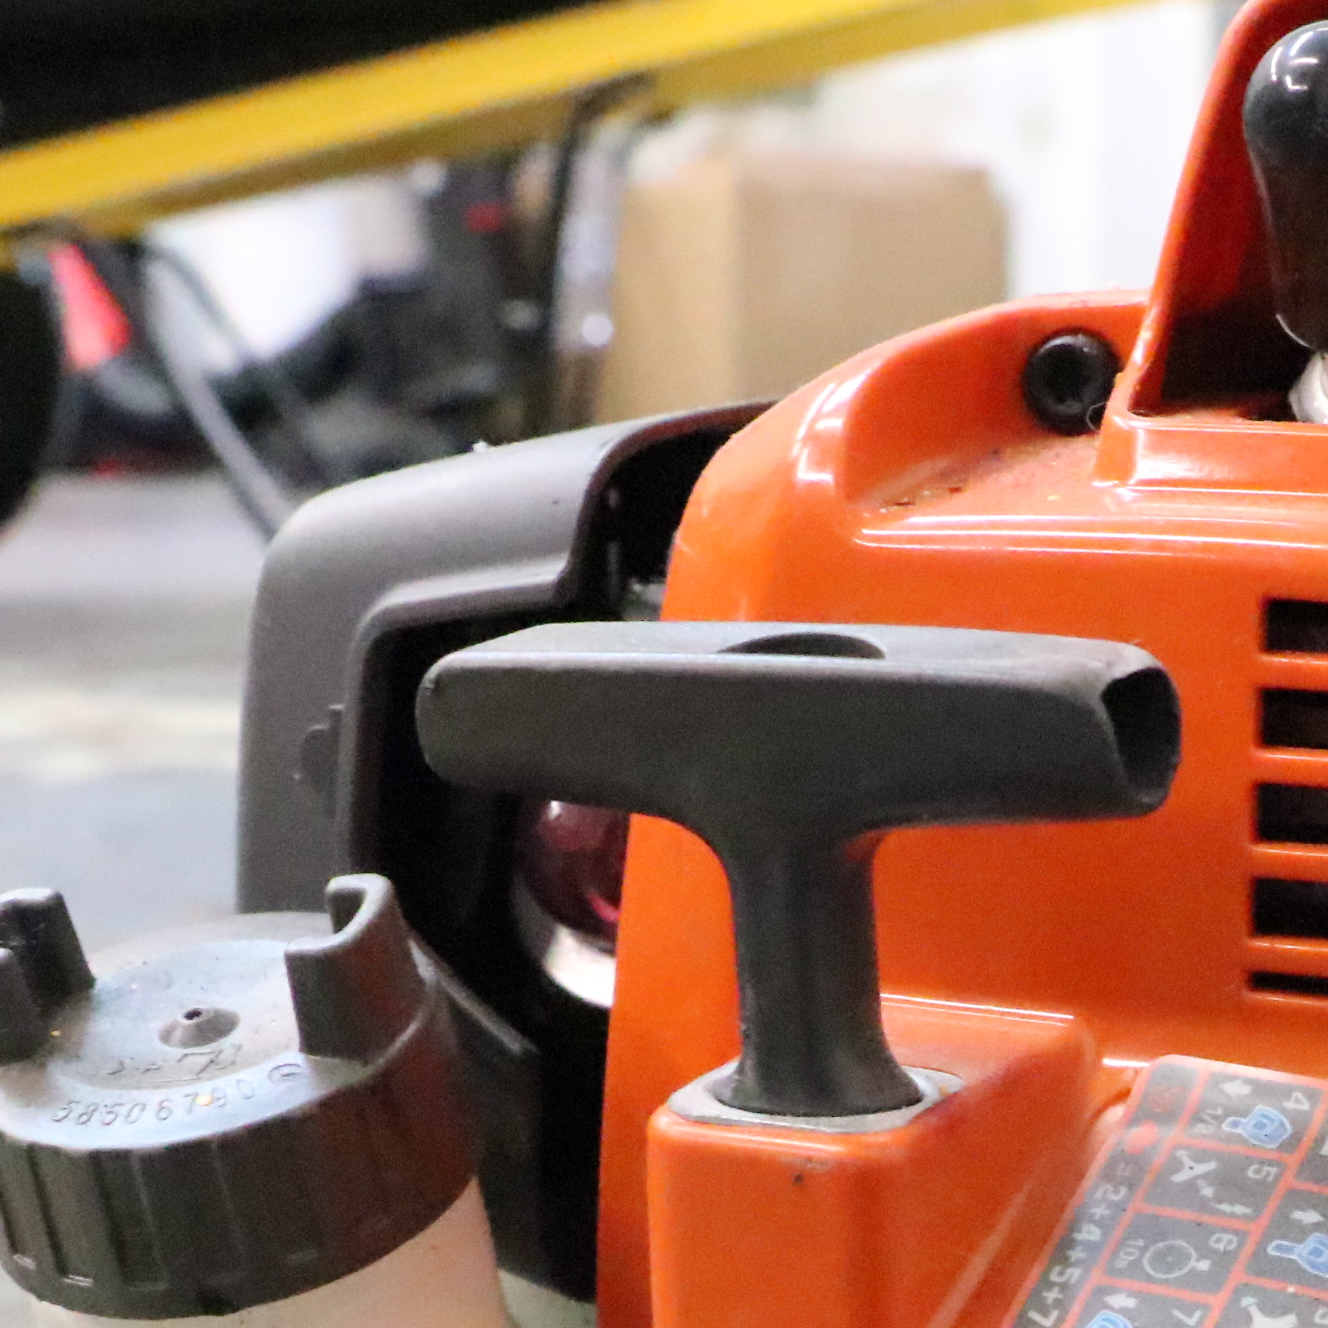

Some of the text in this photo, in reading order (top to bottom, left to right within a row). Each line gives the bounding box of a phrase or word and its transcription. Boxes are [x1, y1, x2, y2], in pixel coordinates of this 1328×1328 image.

[1282, 1091, 1311, 1112] 4
[1246, 1163, 1279, 1183] 5
[1207, 1231, 1239, 1252] 6
[1170, 1307, 1202, 1327] 7
